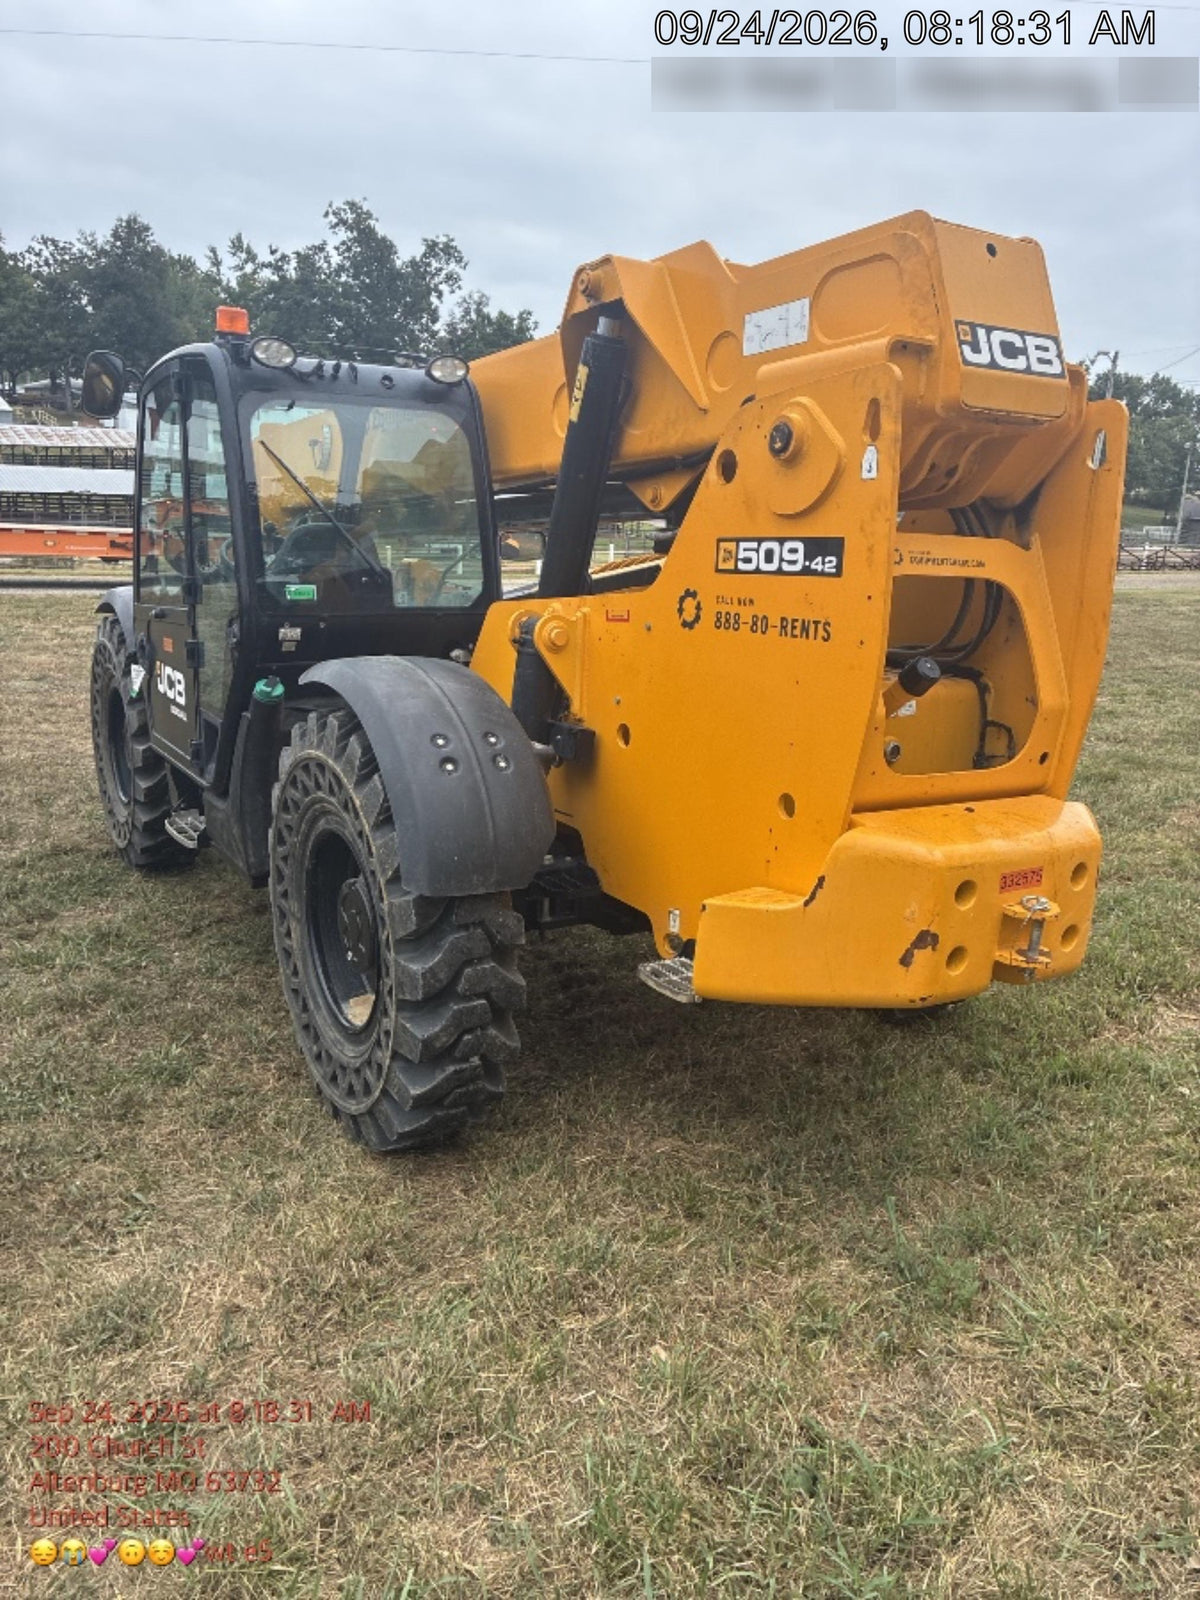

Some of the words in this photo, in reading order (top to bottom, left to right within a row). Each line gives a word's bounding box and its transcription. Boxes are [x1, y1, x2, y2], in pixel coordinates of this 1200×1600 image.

[961, 326, 1062, 374] JCB
[714, 611, 831, 642] 888-80-RENTS
[157, 662, 186, 707] JCB
